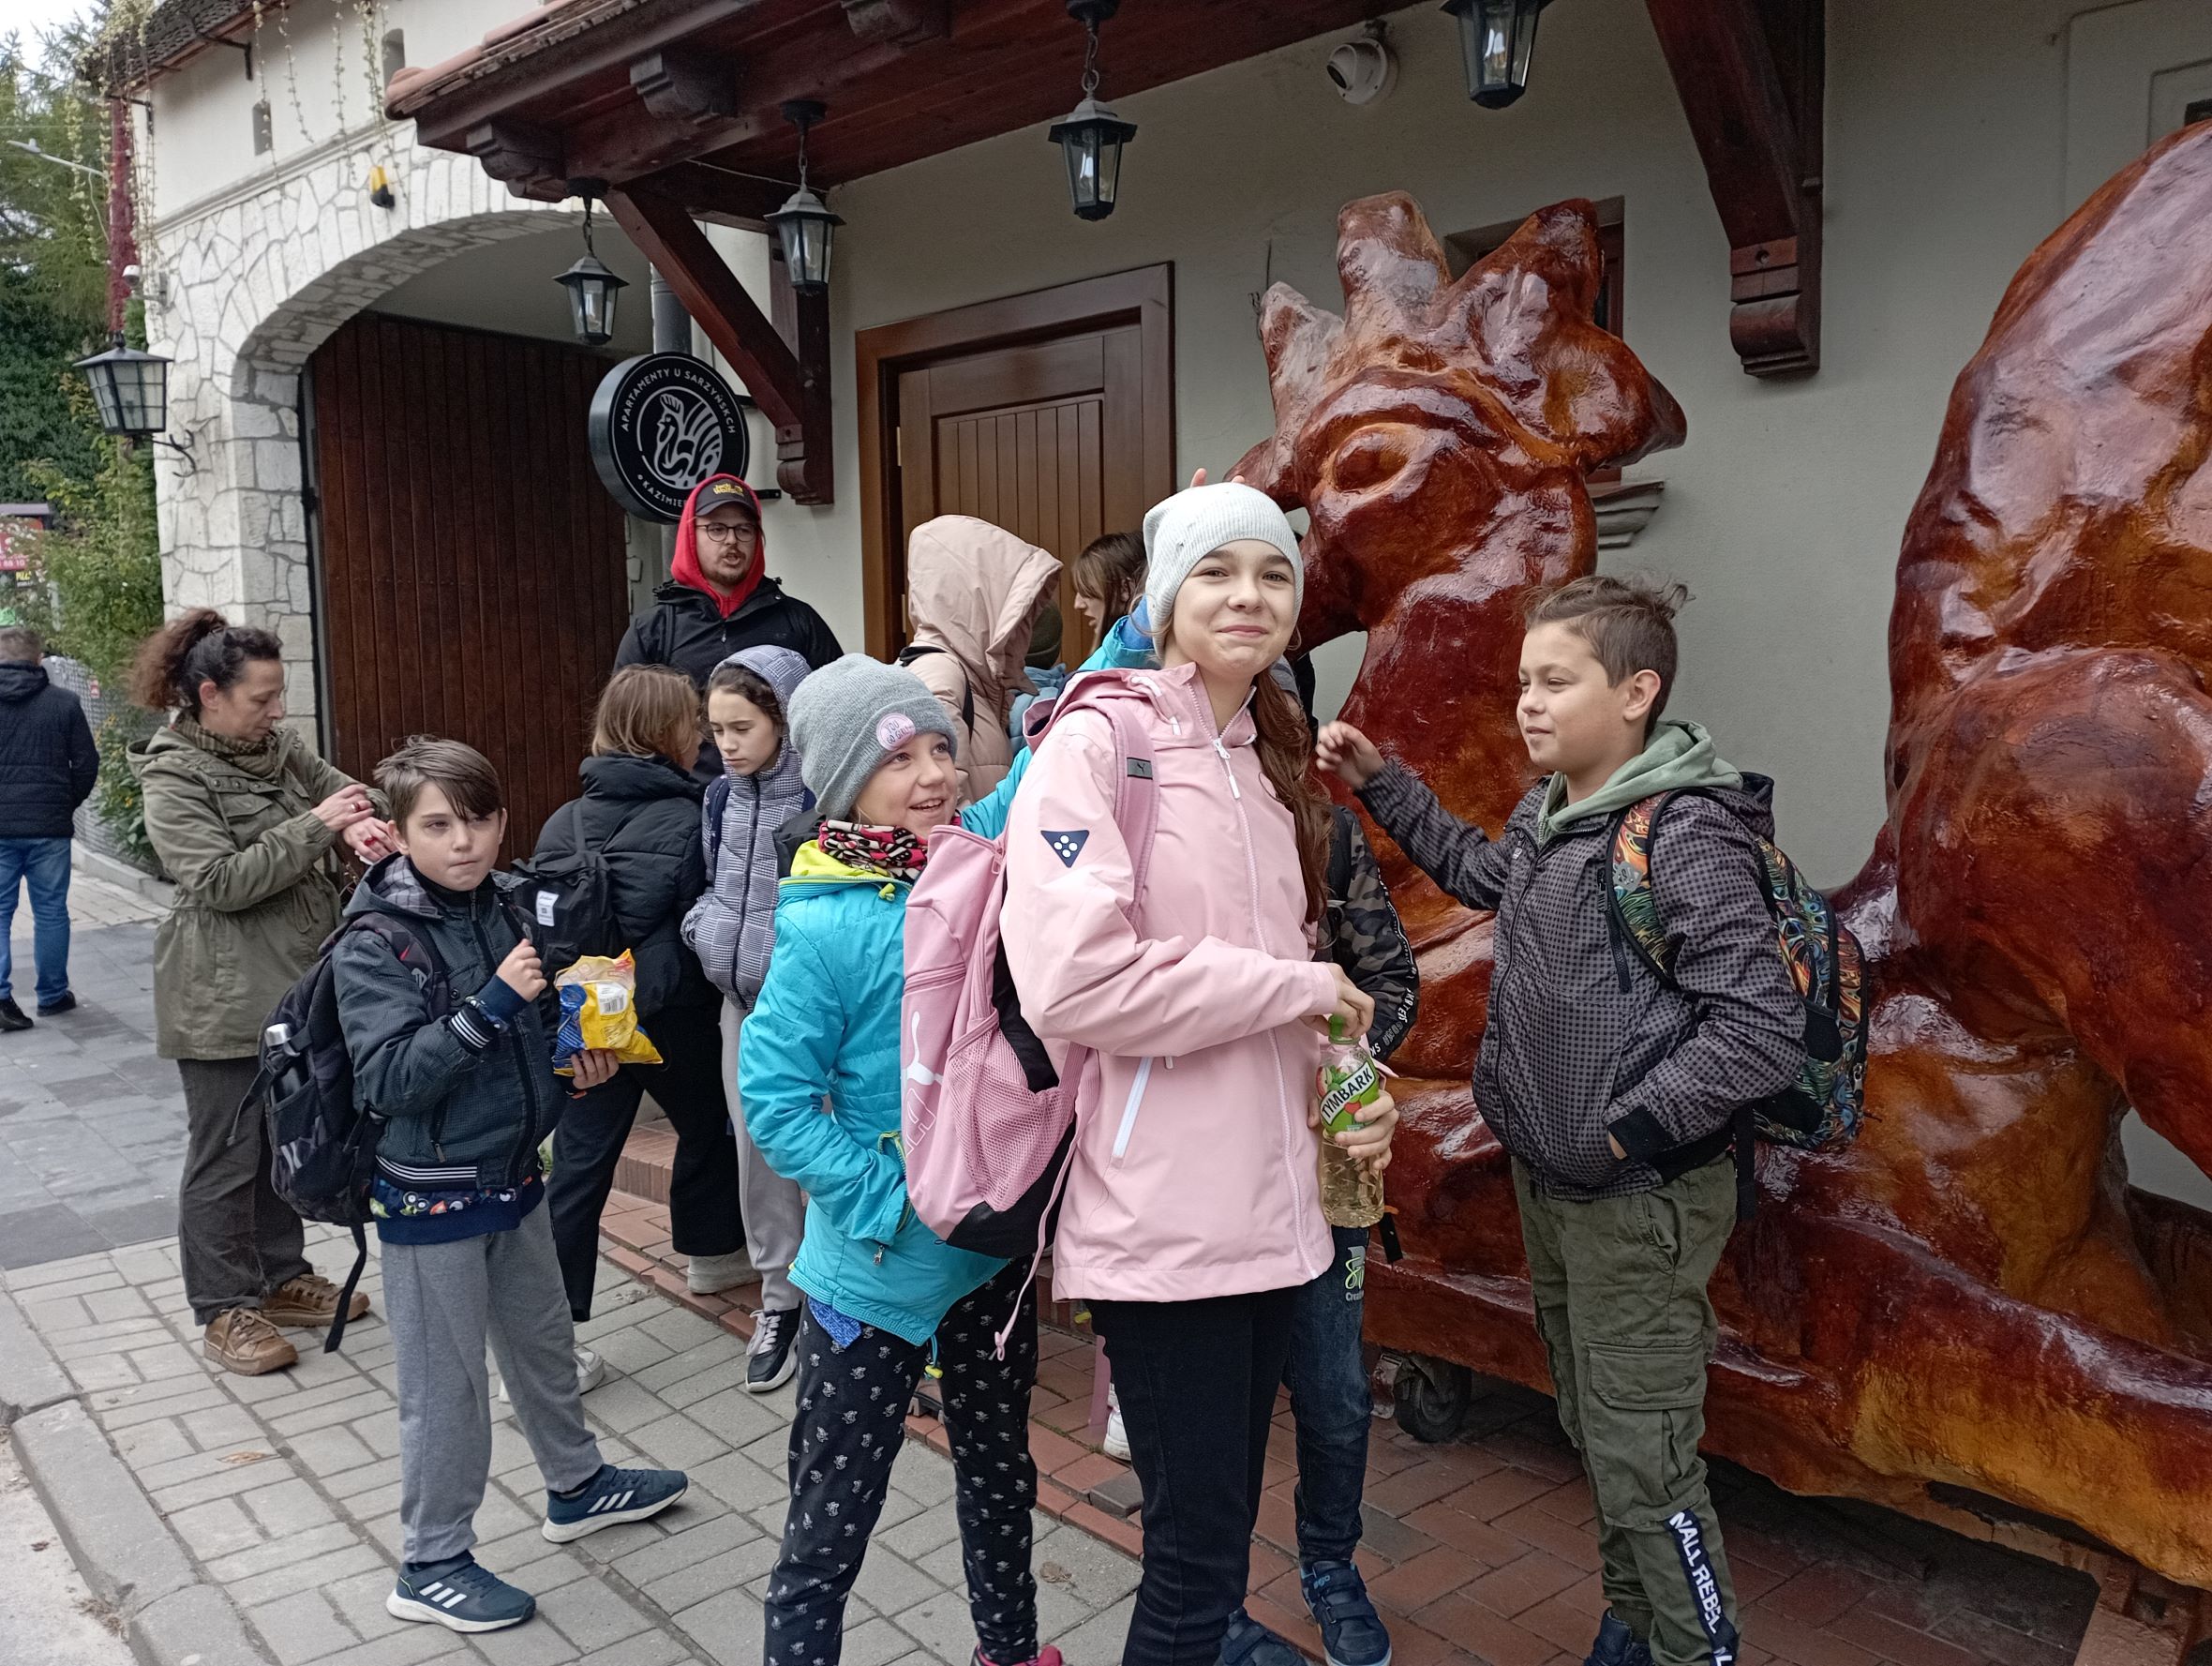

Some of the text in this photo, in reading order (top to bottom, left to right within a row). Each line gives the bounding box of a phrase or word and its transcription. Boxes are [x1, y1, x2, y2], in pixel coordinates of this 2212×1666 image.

[621, 368, 670, 432] APARTAMENTY
[674, 368, 681, 377] U
[884, 719, 900, 733] YOU
[887, 734, 896, 743] GO
[1322, 1067, 1373, 1119] TYMBARK
